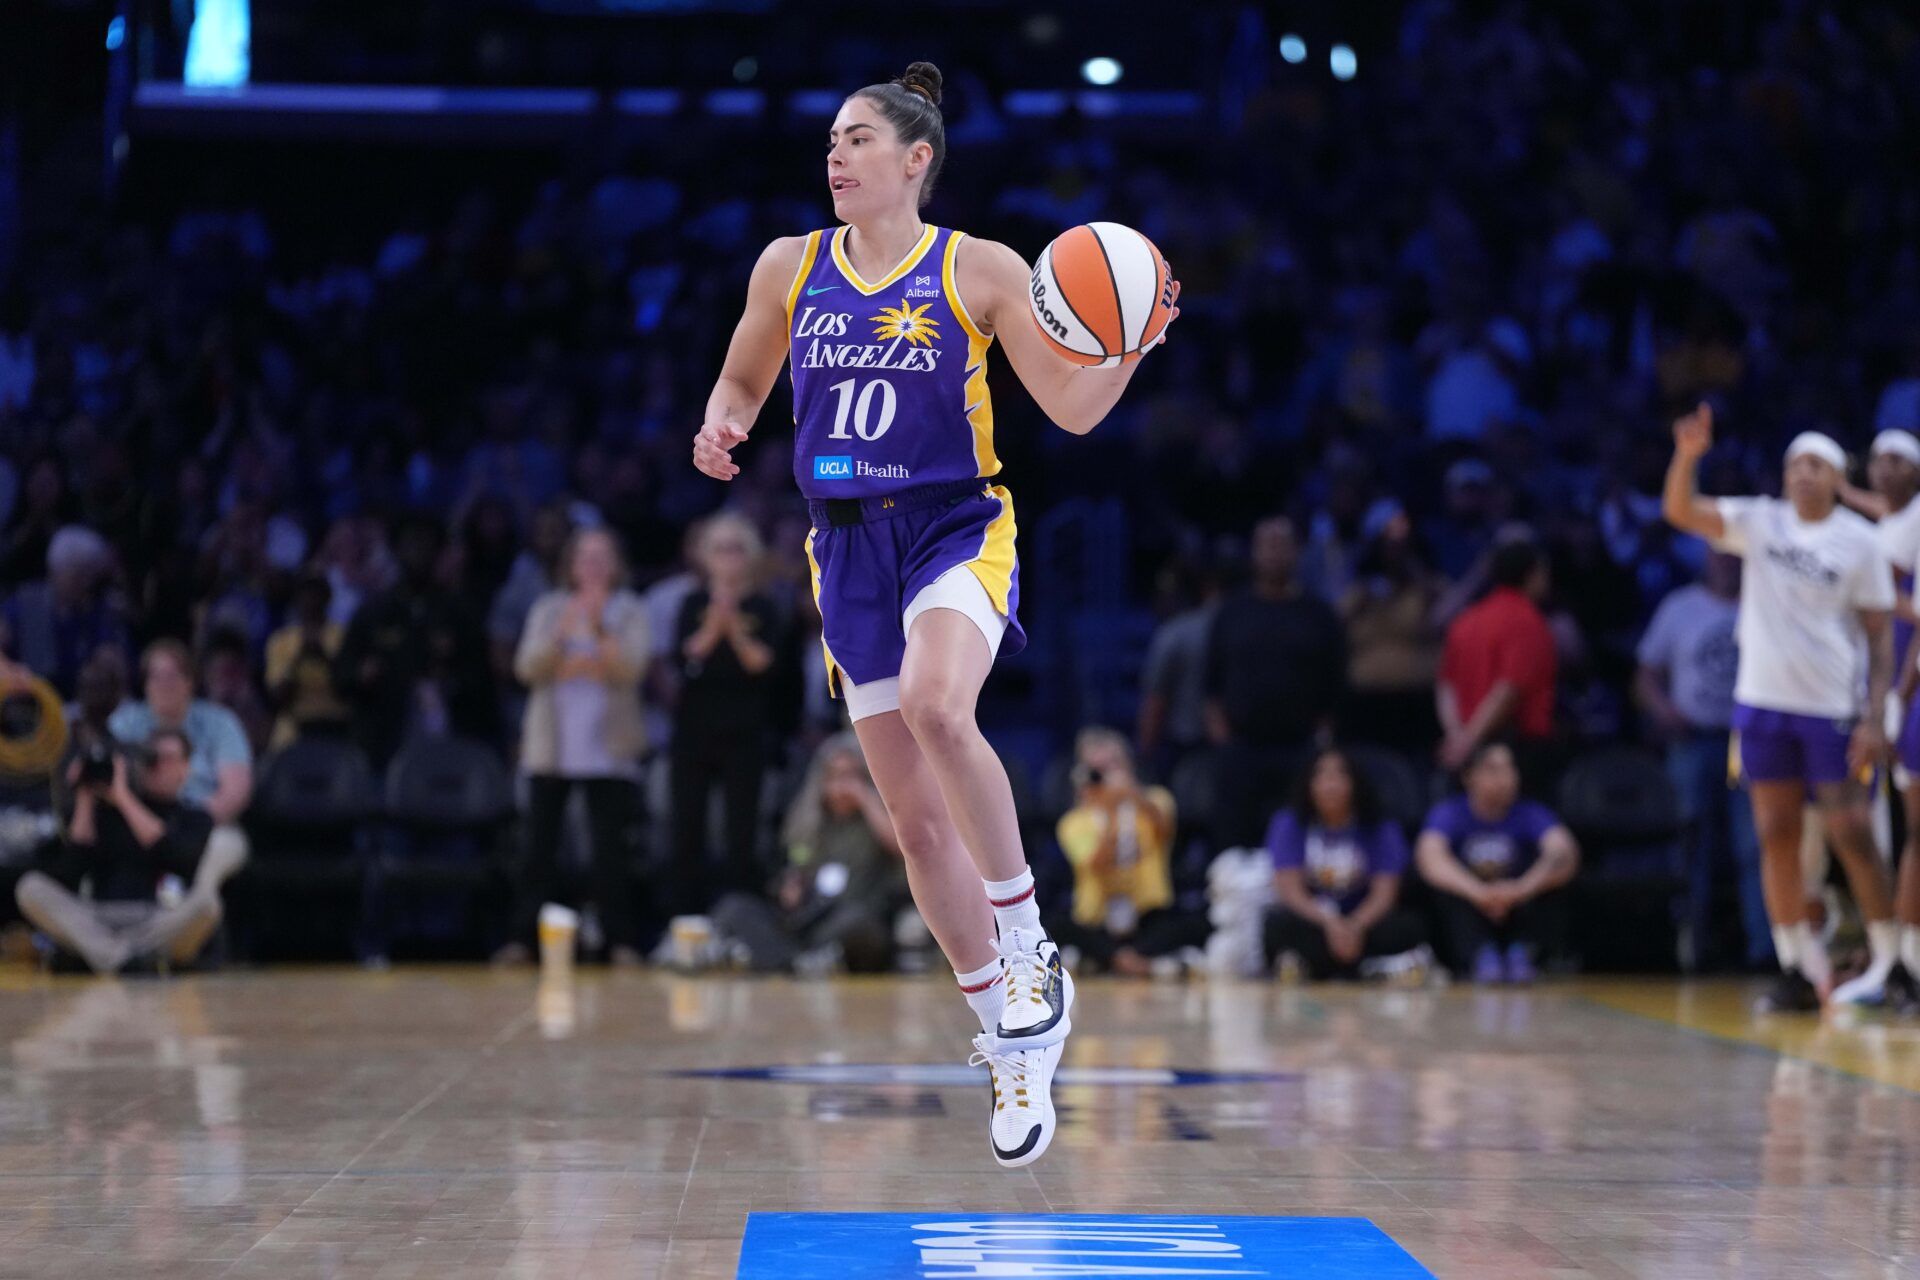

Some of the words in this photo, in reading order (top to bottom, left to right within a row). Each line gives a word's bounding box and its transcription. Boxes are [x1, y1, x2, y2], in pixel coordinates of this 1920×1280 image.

[906, 288, 940, 298] Albert
[795, 307, 853, 338] LOS
[801, 338, 942, 372] ANGELES
[828, 377, 897, 441] 10
[819, 461, 849, 475] UCLA
[856, 460, 910, 479] Health
